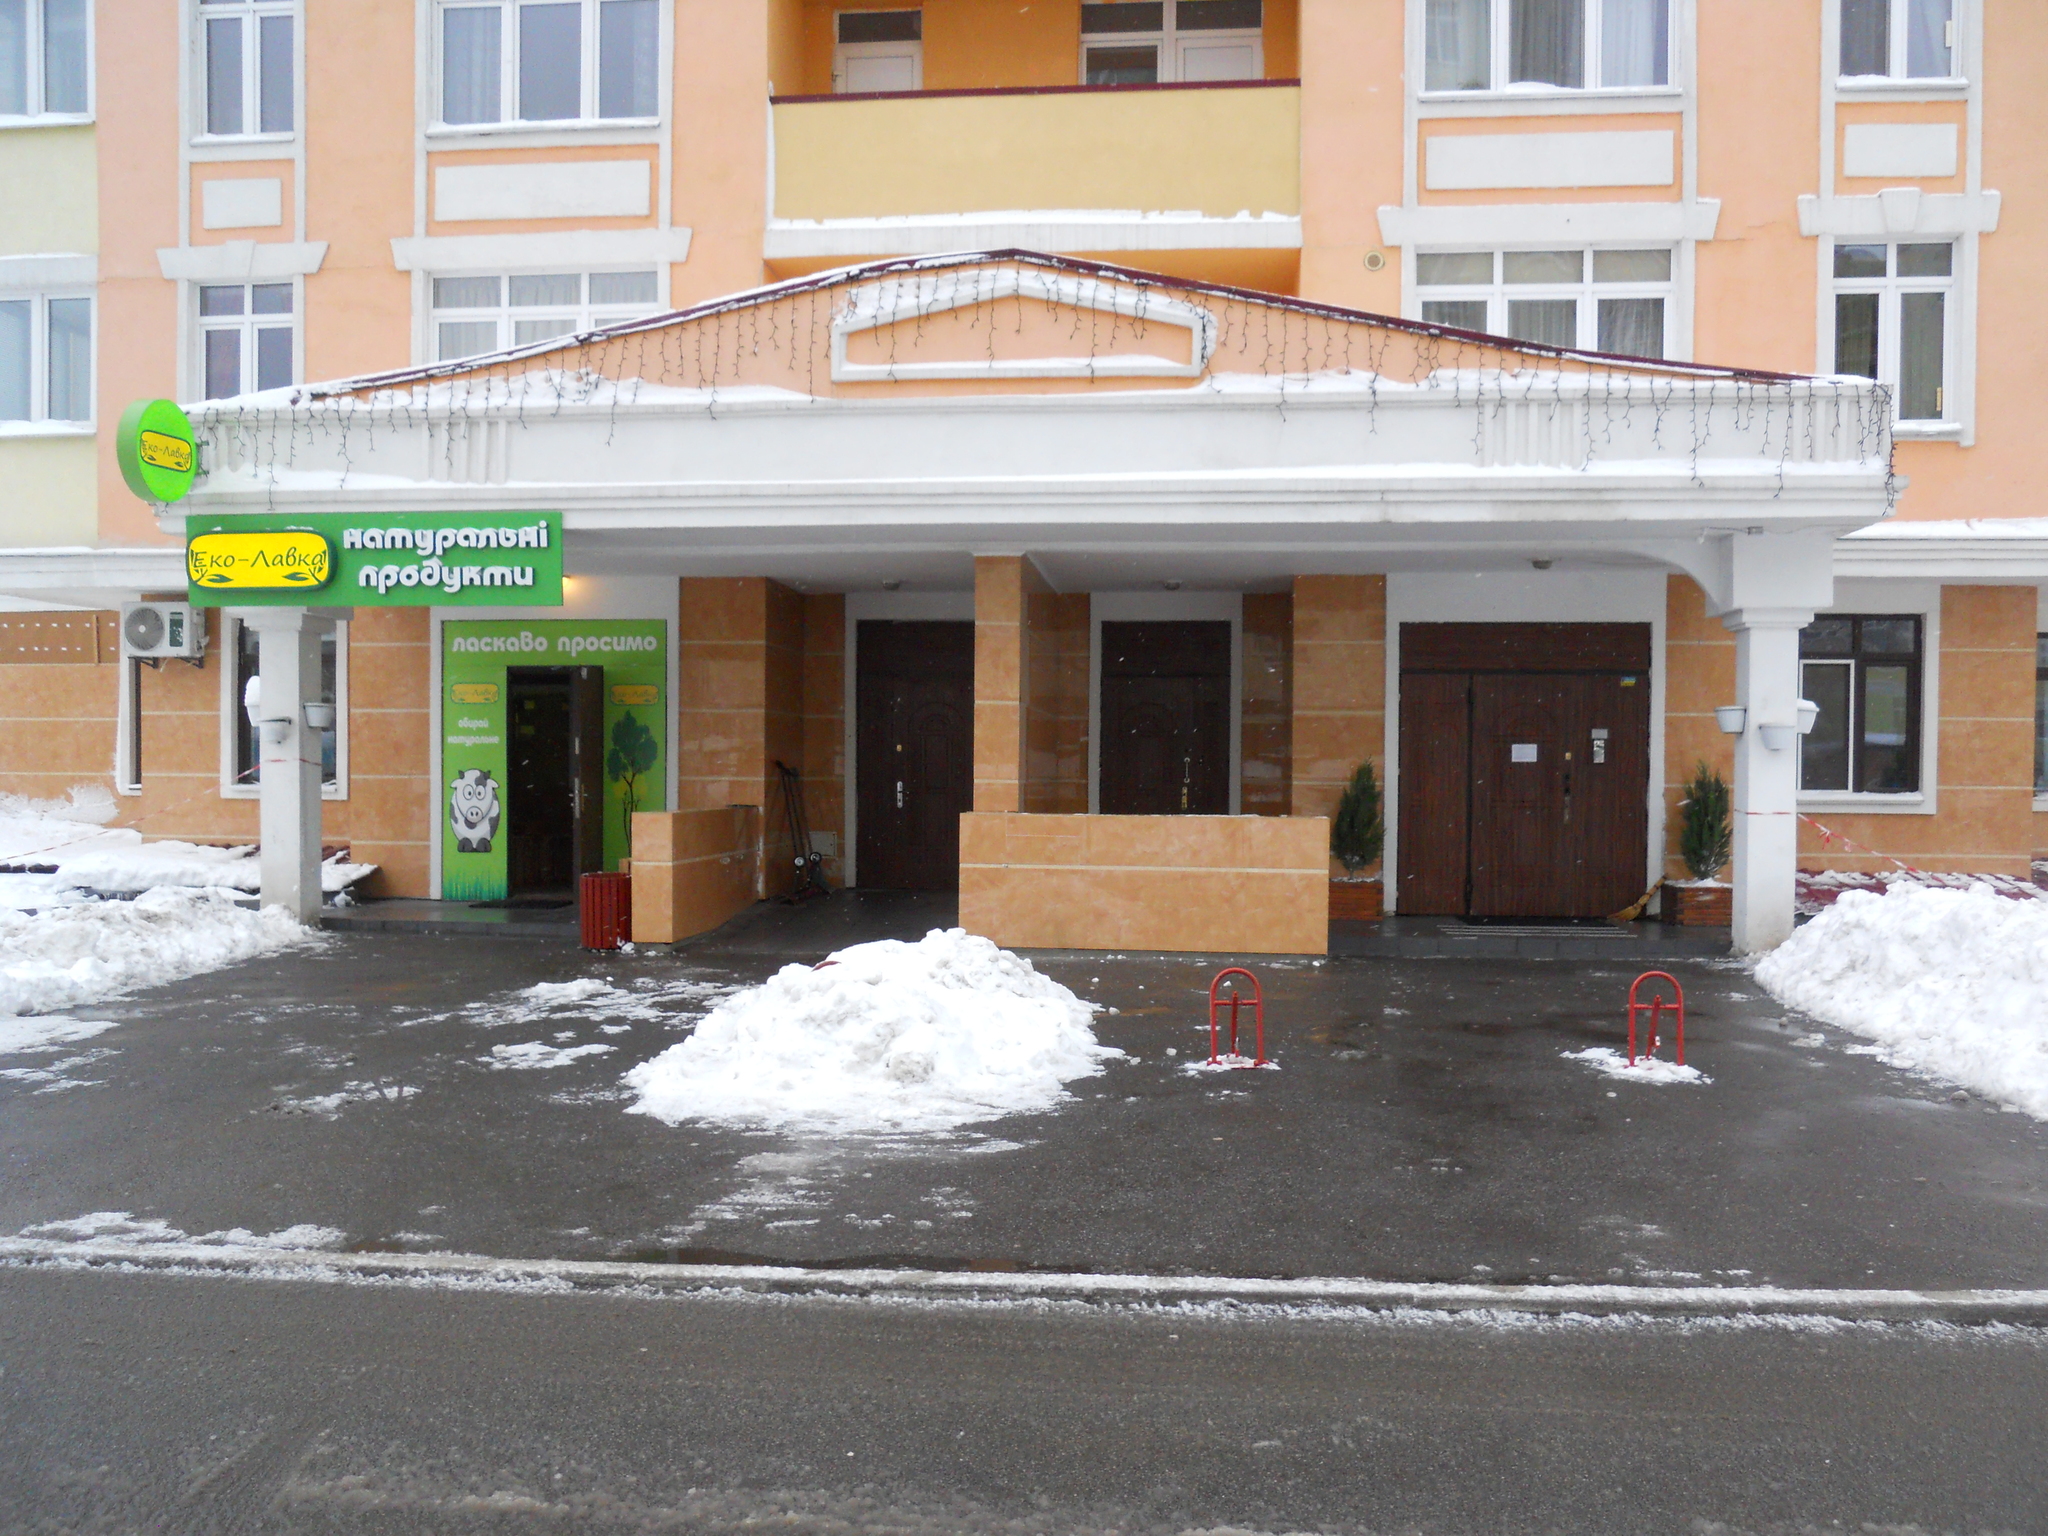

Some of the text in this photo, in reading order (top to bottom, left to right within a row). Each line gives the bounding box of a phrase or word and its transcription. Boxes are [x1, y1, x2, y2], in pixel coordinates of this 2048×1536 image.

[143, 440, 191, 460] Еко-Лавка
[343, 520, 548, 556] натуральні
[193, 546, 324, 568] Еко-Лавка
[358, 556, 534, 594] продукти
[452, 631, 657, 657] ласкаво просимо
